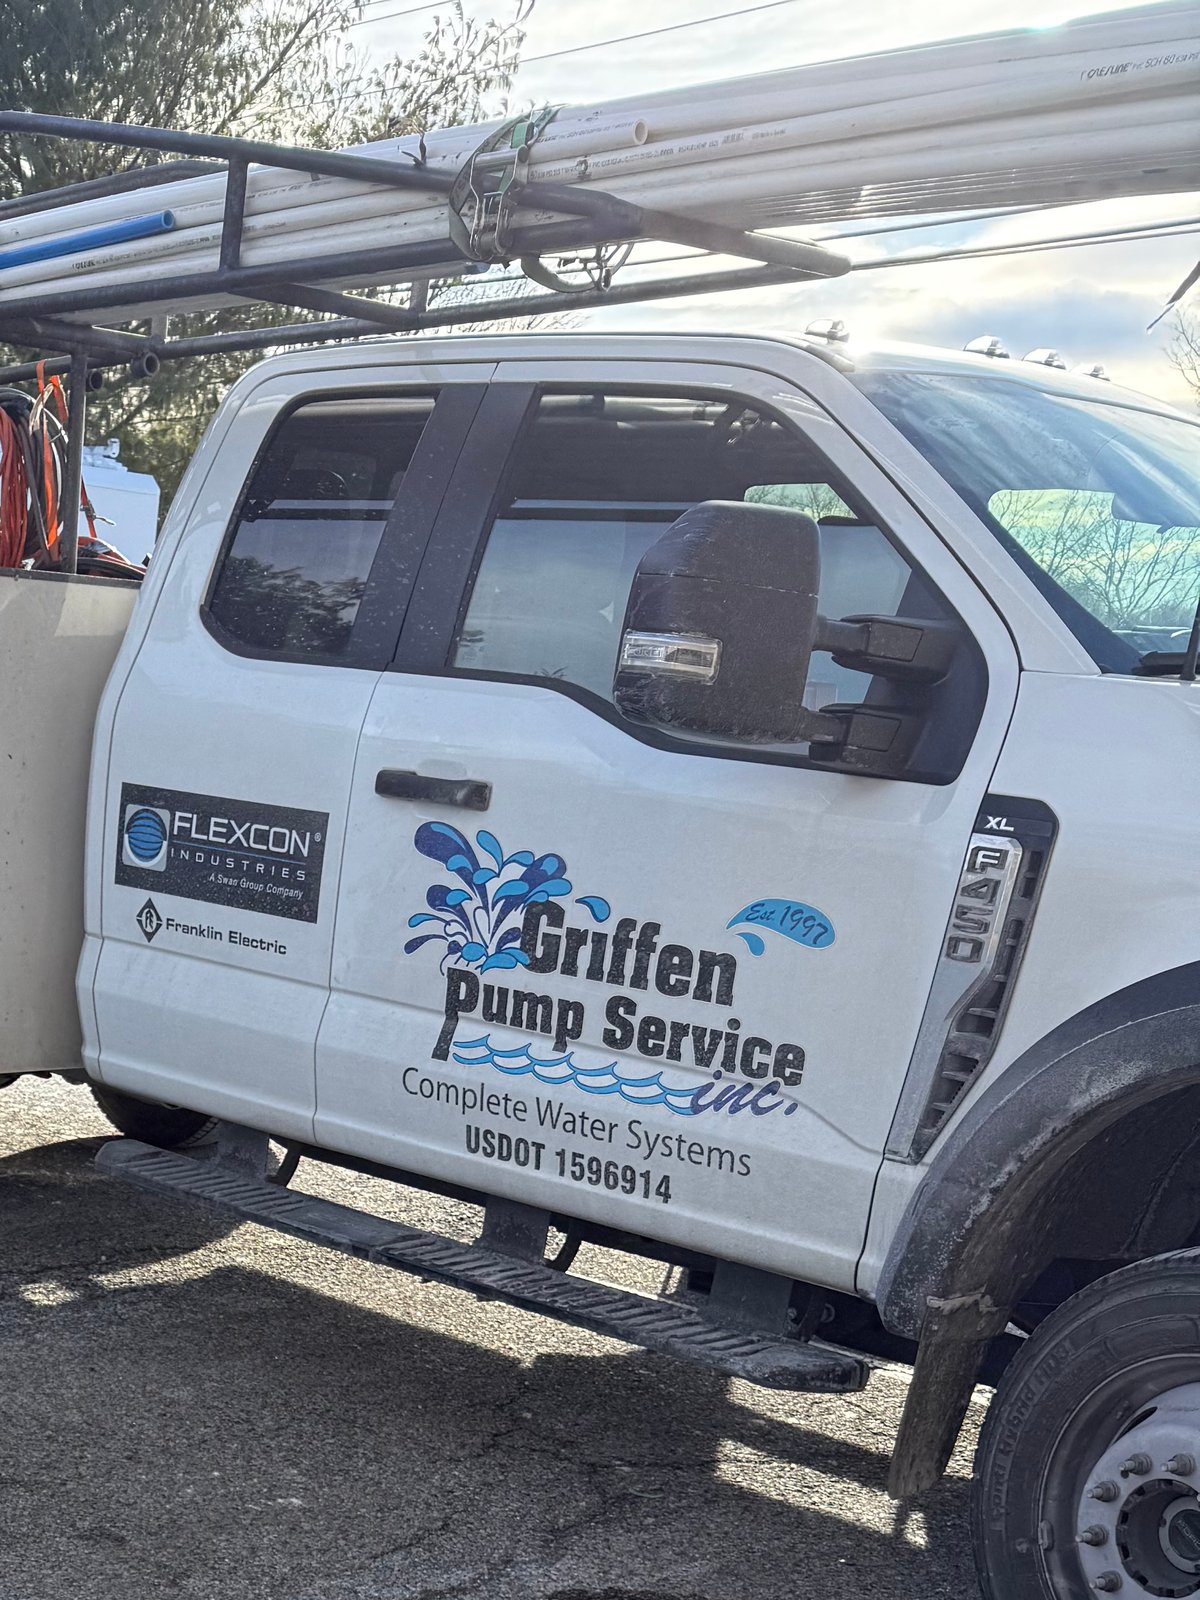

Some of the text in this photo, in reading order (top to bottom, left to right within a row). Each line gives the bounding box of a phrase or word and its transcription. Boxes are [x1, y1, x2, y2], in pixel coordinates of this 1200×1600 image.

[172, 811, 310, 857] FLEXCON
[984, 816, 1015, 832] XL
[171, 848, 306, 881] INDUSTRIES
[209, 873, 304, 900] A Swan Group Company
[166, 918, 287, 955] Franklin Electric
[744, 903, 829, 946] Est. 1997
[521, 900, 737, 1006] Griffen
[431, 967, 806, 1087] Pump Service
[689, 1070, 799, 1116] inc.
[402, 1067, 752, 1177] Complete Water Systems
[466, 1125, 671, 1204] USDOT 1596914
